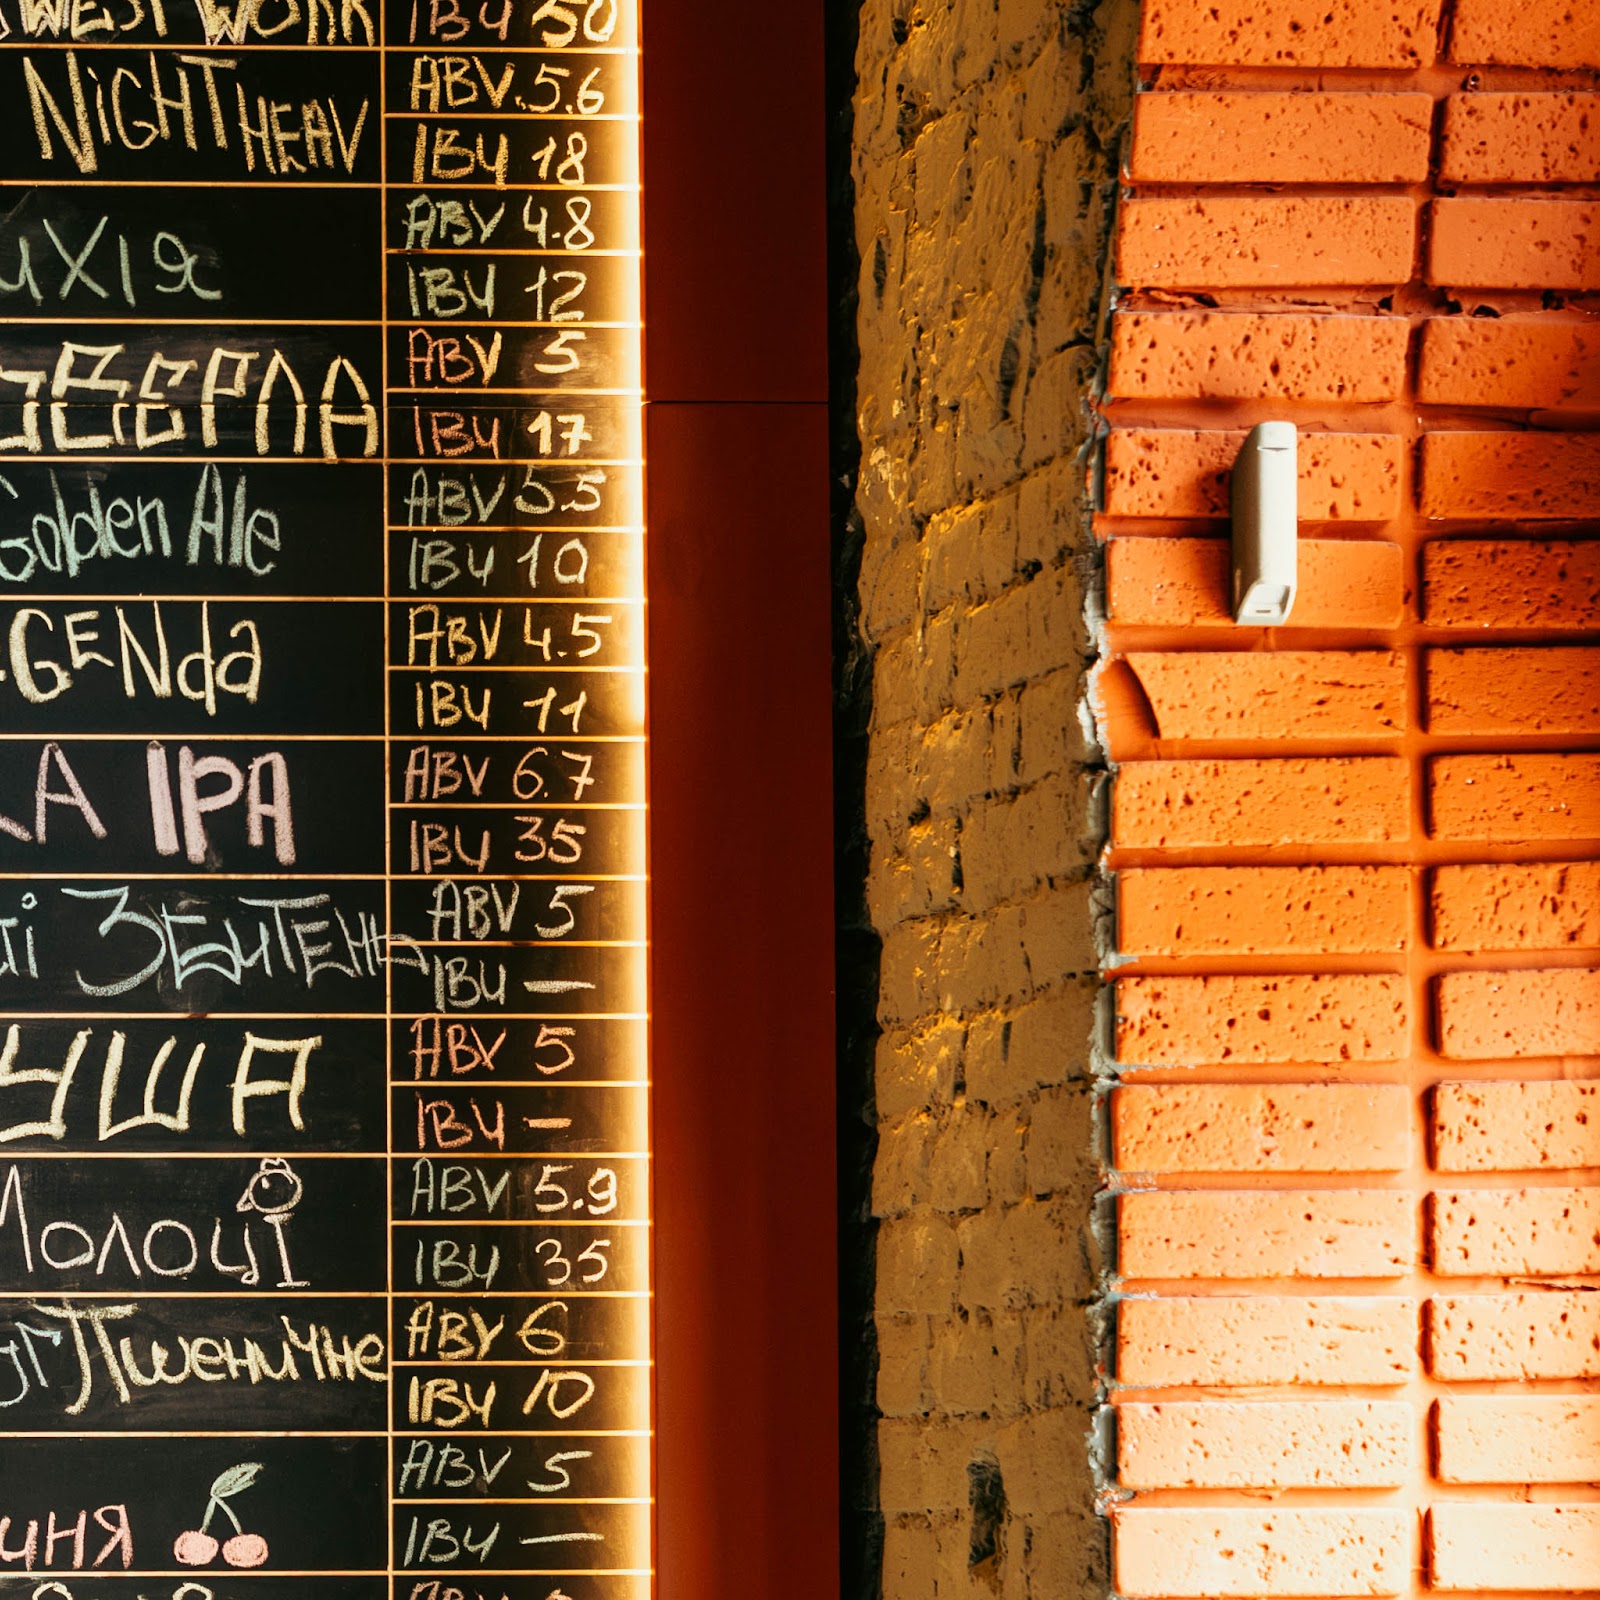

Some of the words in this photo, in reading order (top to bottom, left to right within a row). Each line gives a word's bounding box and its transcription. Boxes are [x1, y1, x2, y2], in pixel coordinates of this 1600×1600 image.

[409, 55, 515, 113] ABV
[532, 132, 588, 185] 18
[402, 194, 505, 249] ABV
[523, 195, 594, 250] 4.8
[524, 265, 587, 322] 12
[406, 327, 501, 388] ABV
[534, 330, 586, 374] 5
[527, 410, 592, 456] 17
[187, 462, 281, 575] Ale
[404, 467, 505, 527] ABV
[516, 534, 588, 588] 10
[408, 603, 501, 673] ABV
[524, 608, 612, 661] 4.5
[524, 687, 586, 733] 11
[404, 745, 490, 796] ABV
[512, 747, 595, 801] 6.7
[146, 740, 299, 867] IPA
[514, 816, 586, 863] 35
[427, 878, 518, 941] ABV
[534, 885, 595, 938] 5
[409, 1017, 506, 1079] ABV
[534, 1025, 576, 1075] 5
[411, 1157, 511, 1214] ABV
[534, 1165, 617, 1214] 5.9
[535, 1238, 611, 1285] 35
[404, 1300, 503, 1361] ABV
[517, 1301, 568, 1355] 6
[523, 1370, 594, 1418] 10
[400, 1439, 511, 1493] ABV
[527, 1450, 593, 1491] 5
